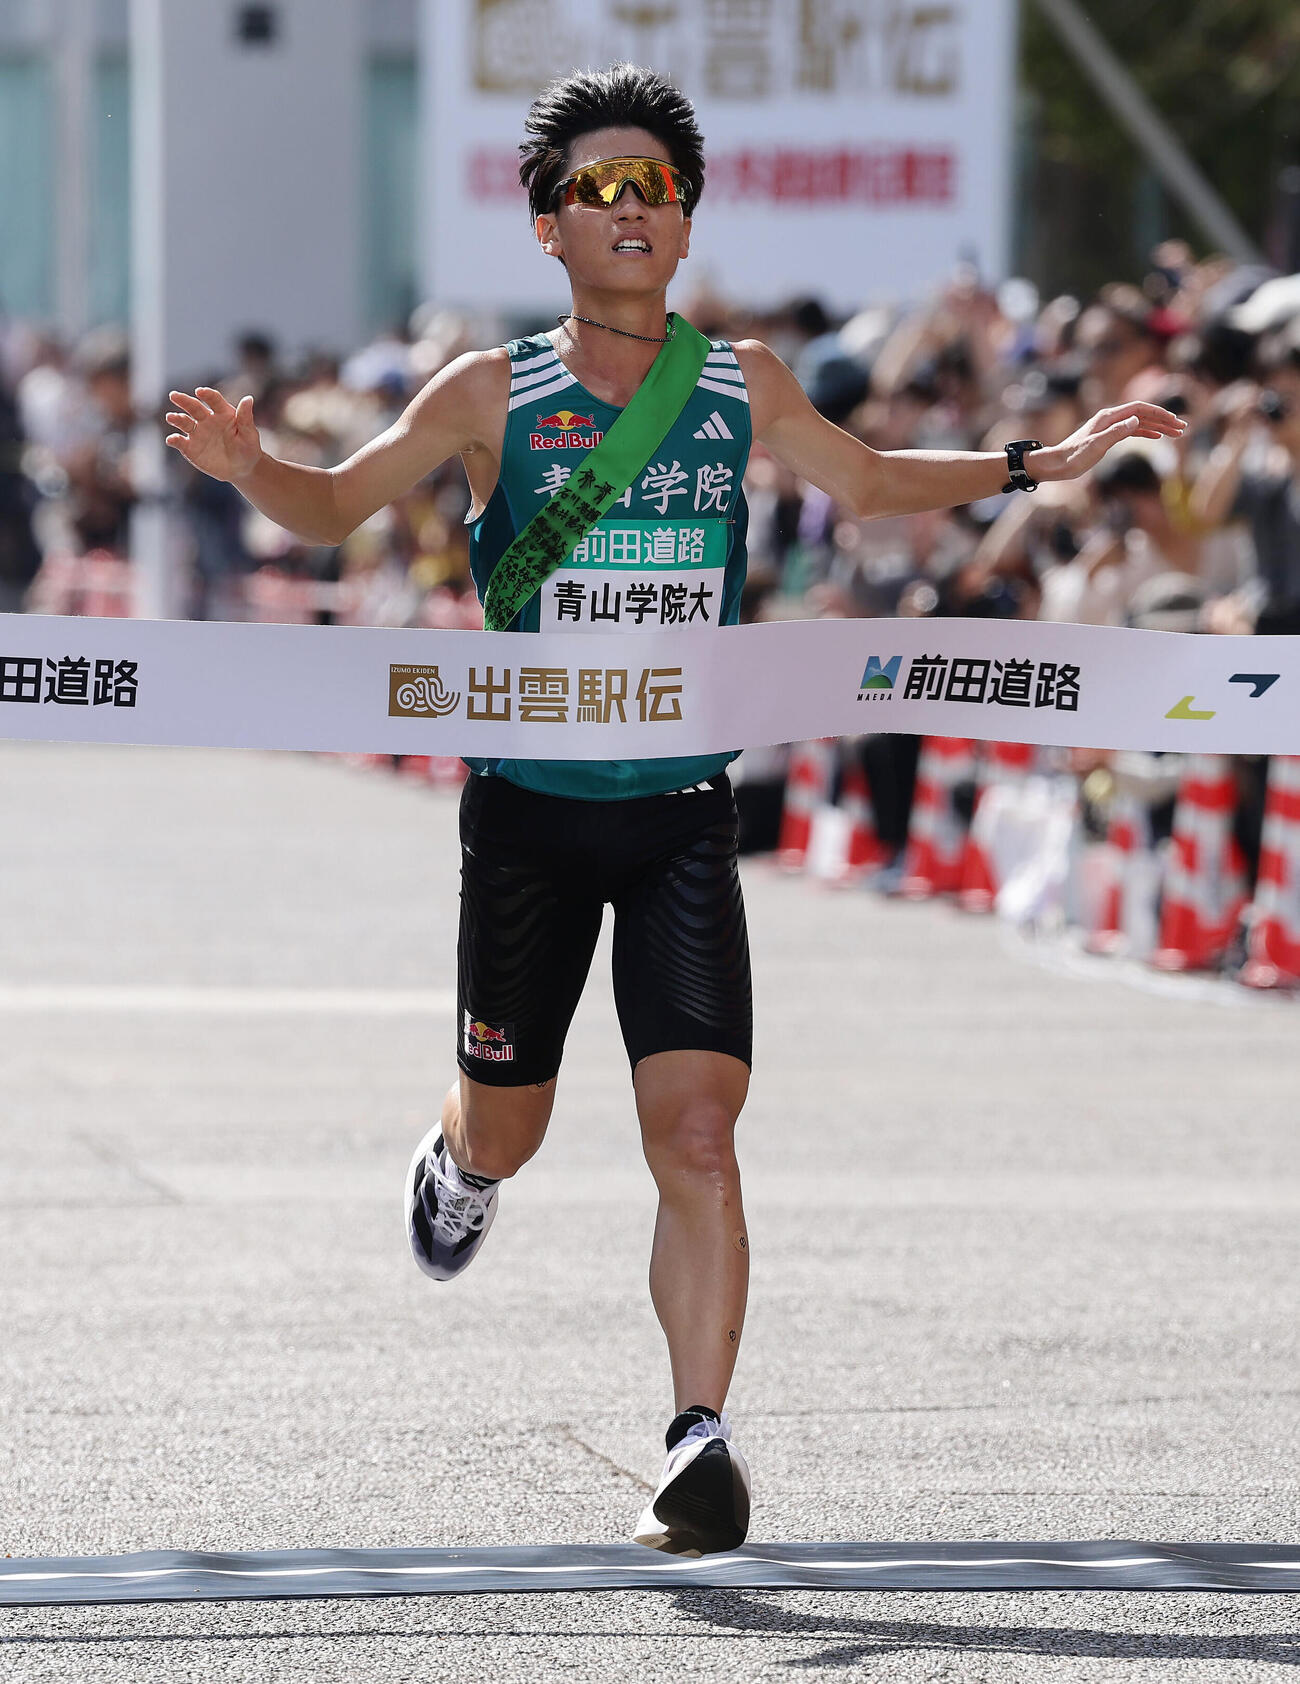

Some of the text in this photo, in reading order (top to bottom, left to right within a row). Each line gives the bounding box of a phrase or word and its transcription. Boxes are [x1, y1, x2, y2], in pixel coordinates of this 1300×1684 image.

[530, 432, 567, 450] Red
[572, 527, 705, 564] 前田道路
[553, 580, 713, 625] 青山学院大
[0, 655, 138, 707] 田道路
[412, 667, 435, 675] EKIDEN
[902, 653, 1081, 712] 前田道路
[466, 666, 683, 723] 出雲駅伝
[856, 693, 892, 701] MAEDA
[467, 1042, 513, 1060] ed Bull
